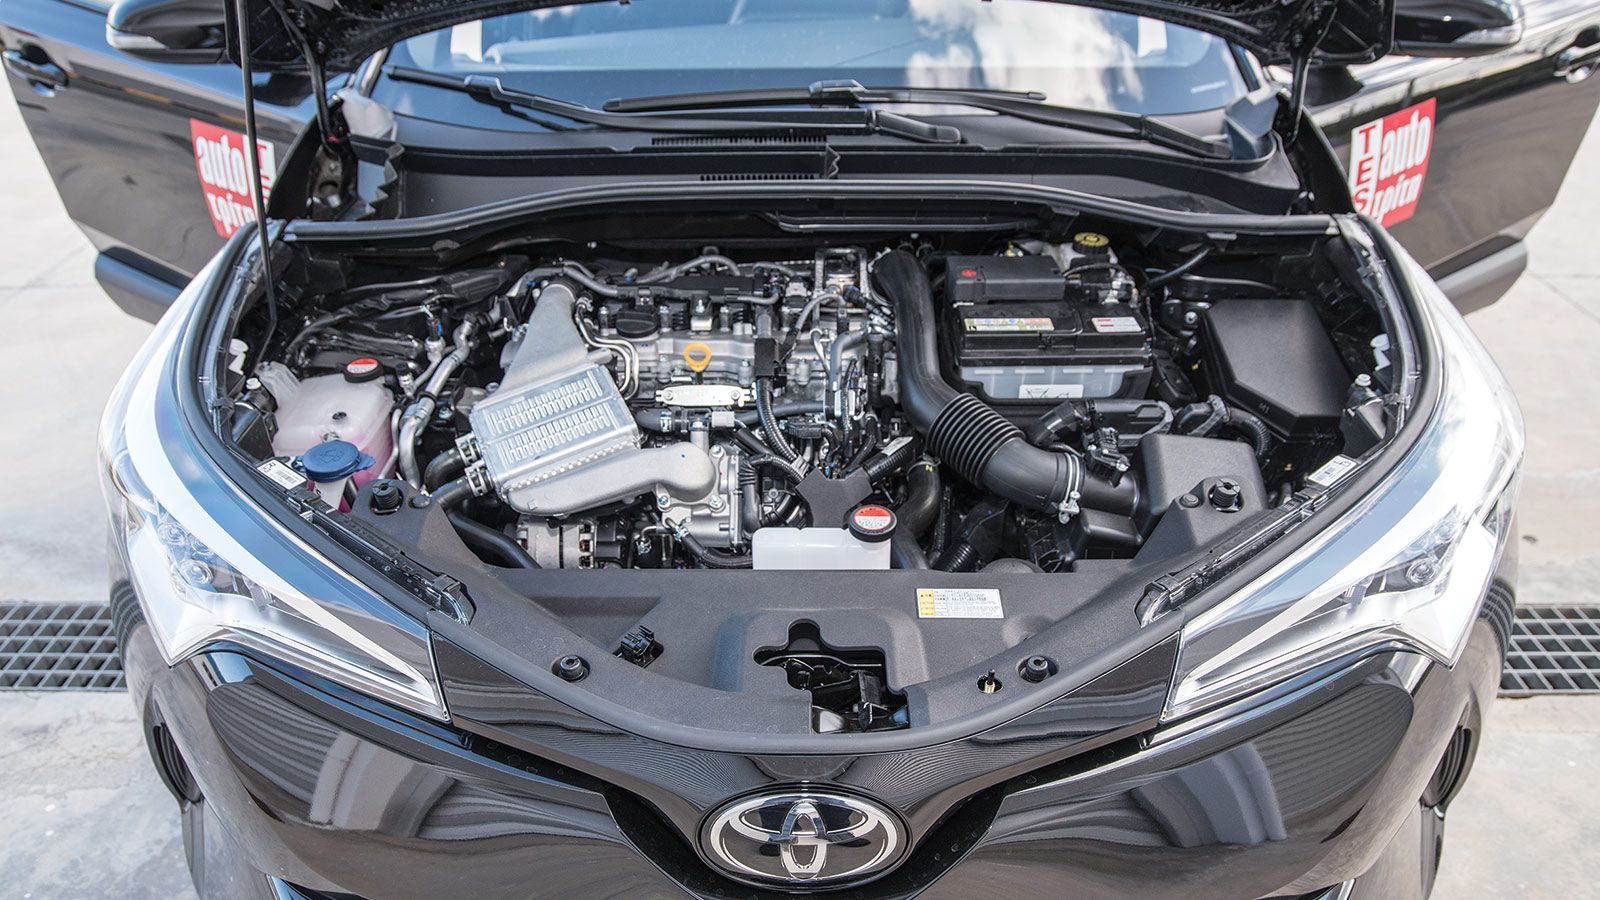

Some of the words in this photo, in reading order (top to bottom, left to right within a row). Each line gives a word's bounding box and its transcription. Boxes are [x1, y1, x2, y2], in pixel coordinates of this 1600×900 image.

[196, 135, 248, 196] auto
[1354, 125, 1376, 211] TES
[1379, 109, 1431, 180] auto
